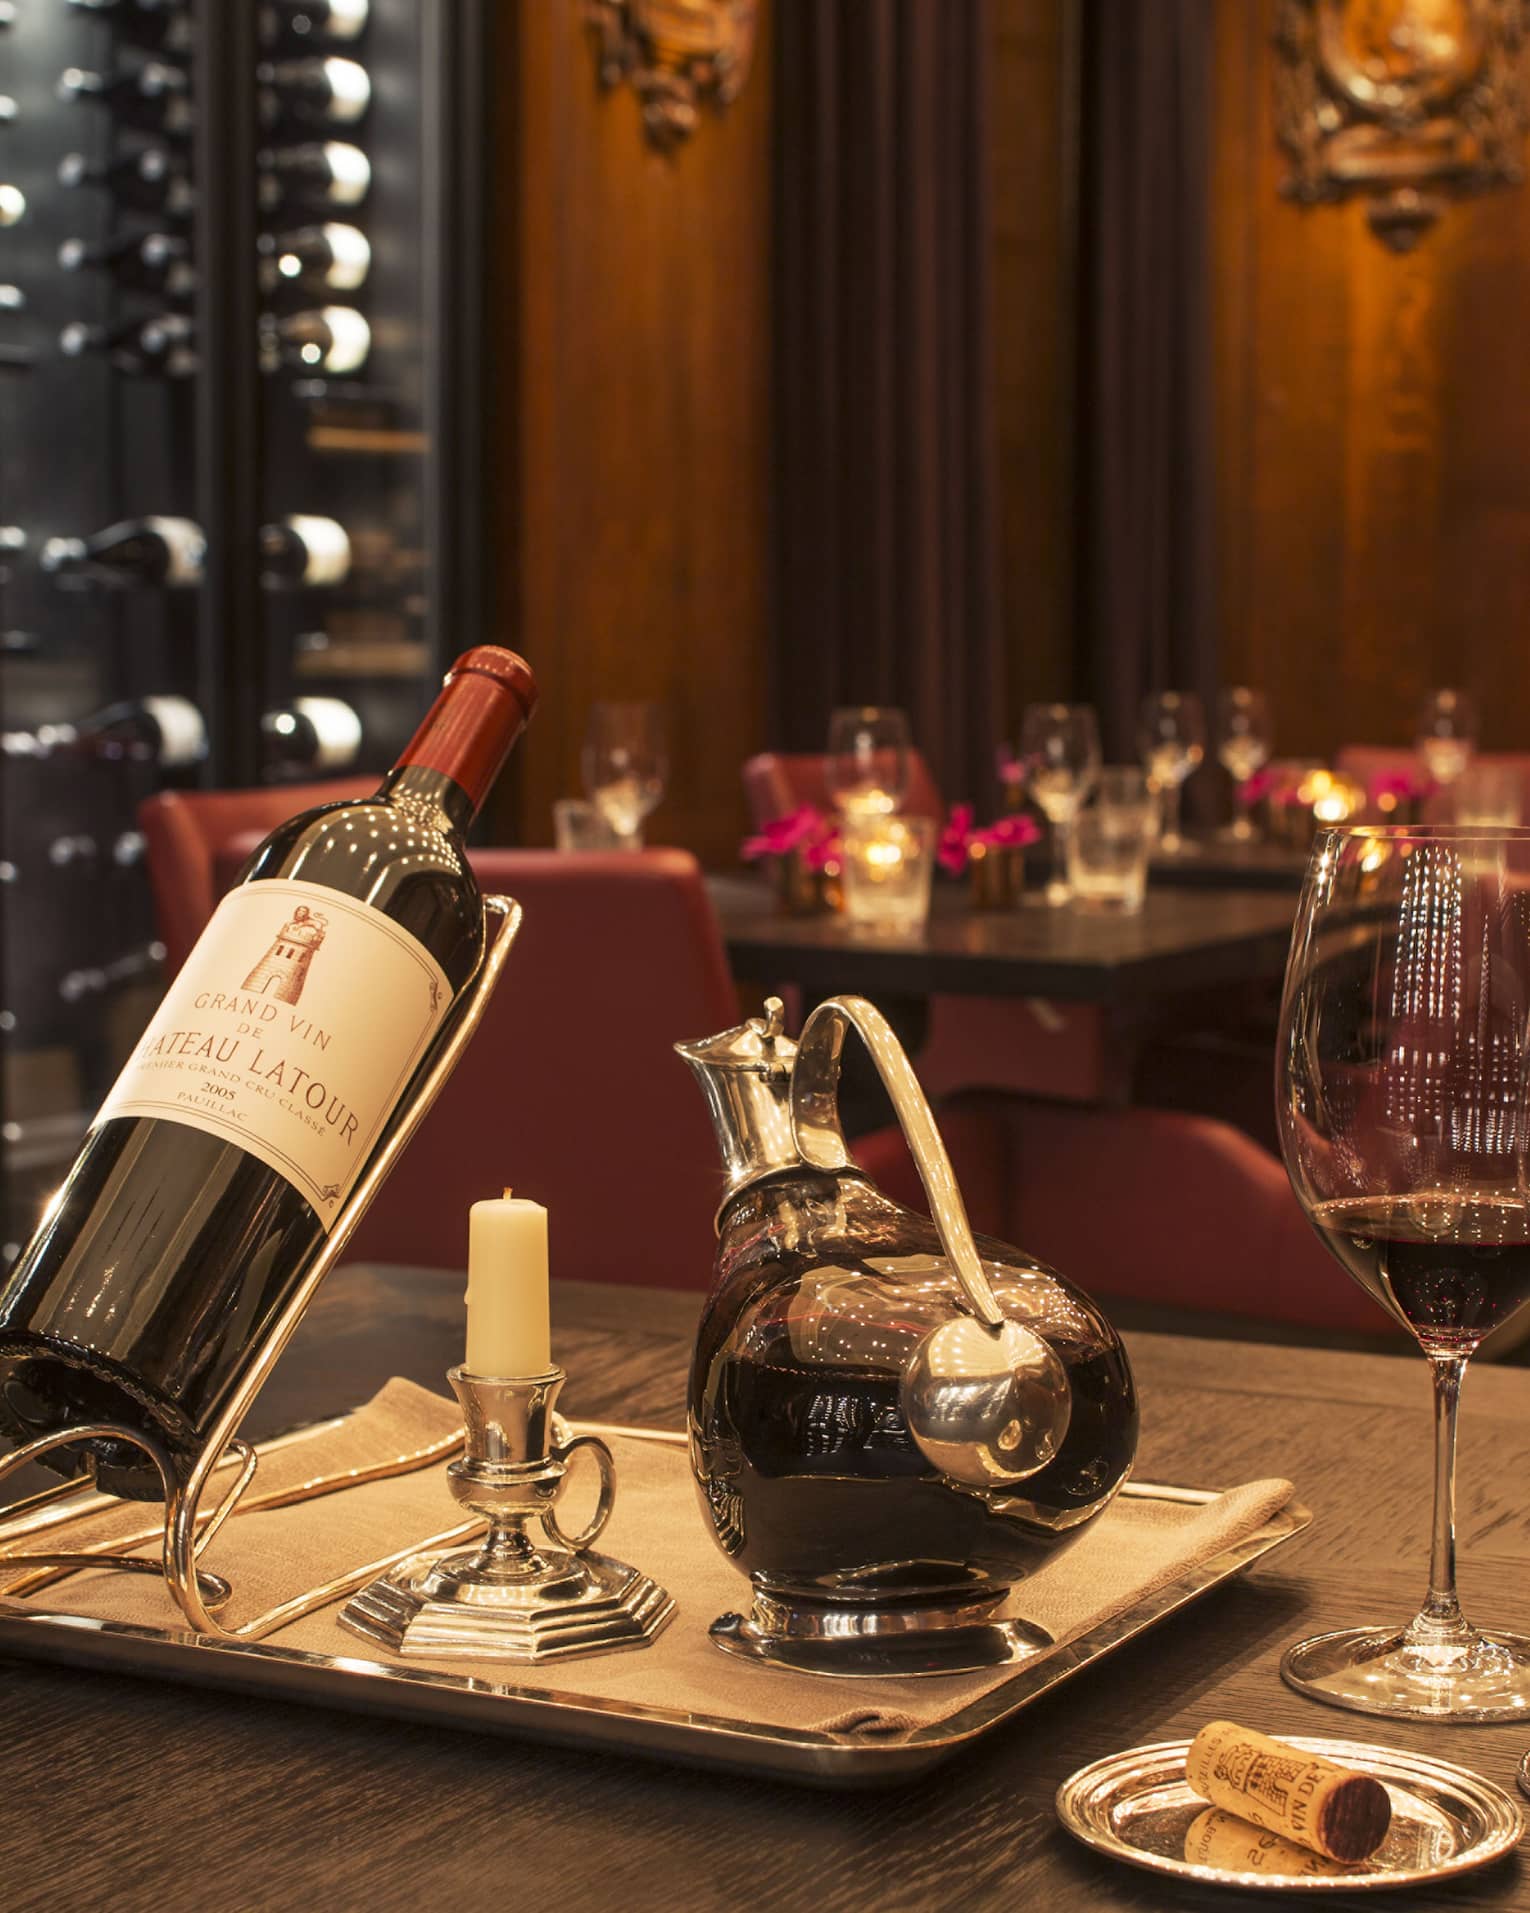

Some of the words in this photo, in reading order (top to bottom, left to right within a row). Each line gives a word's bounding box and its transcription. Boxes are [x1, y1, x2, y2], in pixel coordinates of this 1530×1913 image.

[194, 992, 278, 1022] GRAND
[289, 1015, 331, 1051] VIN
[236, 1022, 264, 1040] DE
[142, 1031, 240, 1062] ATEAU
[247, 1048, 359, 1146] LATOUR
[188, 1064, 241, 1082] GRAND
[245, 1080, 276, 1100] CRU
[200, 1082, 237, 1101] 2005
[177, 1091, 249, 1121] PAUILLAC
[1298, 1772, 1325, 1797] DE
[1291, 1799, 1308, 1831] VIN
